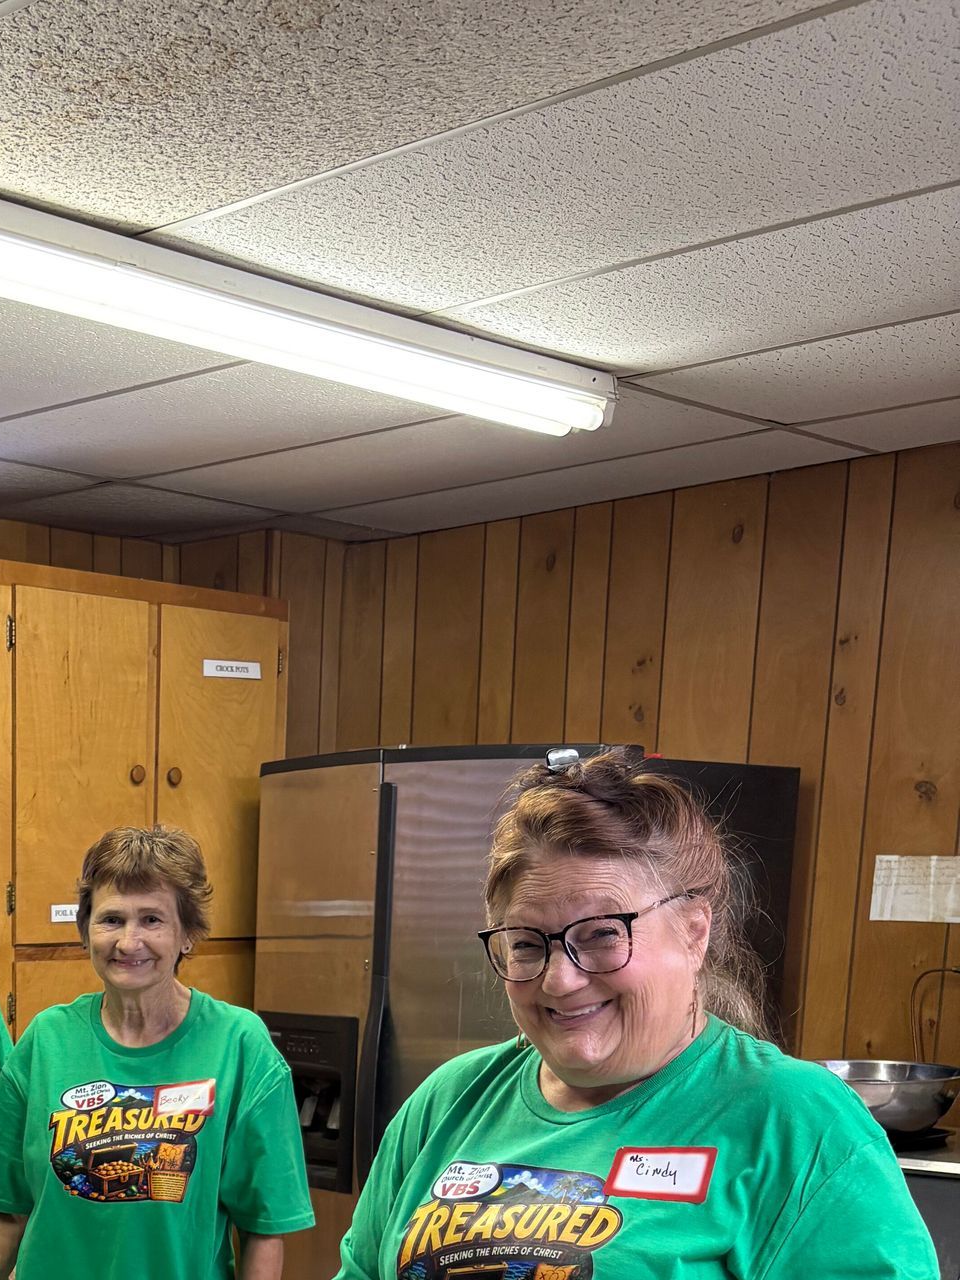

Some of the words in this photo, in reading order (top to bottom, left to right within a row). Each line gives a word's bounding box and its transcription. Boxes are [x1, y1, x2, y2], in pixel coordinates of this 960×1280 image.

[75, 1094, 104, 1108] VBS
[51, 1106, 205, 1157] TREASURED
[85, 1137, 112, 1150] SEEKING
[112, 1134, 124, 1142] THE
[155, 1132, 176, 1140] CHRIST
[447, 1165, 465, 1175] Mt.
[468, 1166, 491, 1176] Zion
[636, 1161, 677, 1186] Cindy
[441, 1180, 481, 1197] VBS
[399, 1199, 621, 1270] TREASURED
[440, 1250, 474, 1266] SEEKING
[476, 1248, 490, 1256] THE
[491, 1246, 520, 1256] RICHES
[520, 1246, 532, 1255] OF
[532, 1246, 563, 1259] CHRIST
